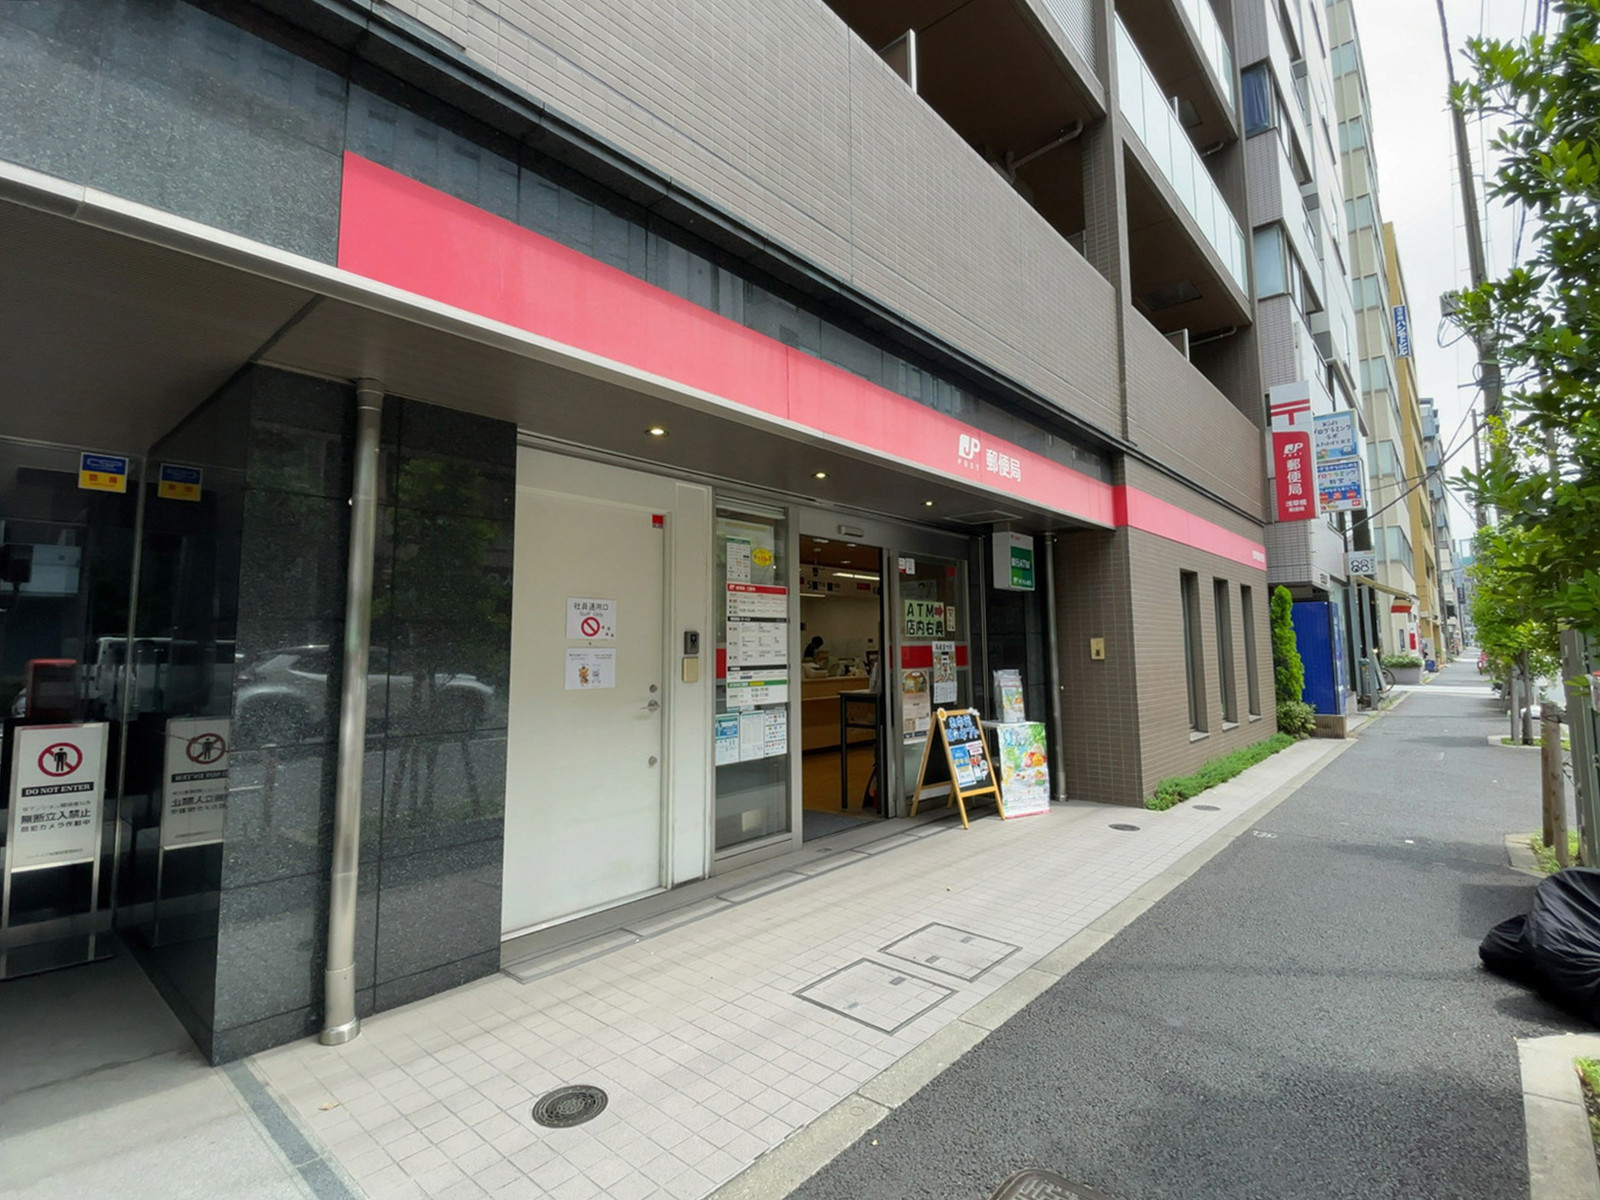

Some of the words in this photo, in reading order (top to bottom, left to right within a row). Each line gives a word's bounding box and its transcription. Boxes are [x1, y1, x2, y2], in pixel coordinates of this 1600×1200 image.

[957, 458, 980, 472] POST
[985, 448, 1022, 483] 郵便局
[1286, 458, 1303, 497] 郵便局
[573, 602, 609, 612] 社員通用口
[906, 602, 935, 618] ATM
[25, 788, 39, 796] DO
[40, 786, 59, 794] NOT
[60, 784, 91, 792] ENTER
[21, 808, 92, 824] 無断立入禁止
[21, 819, 91, 833] 防犯カメラ作動中
